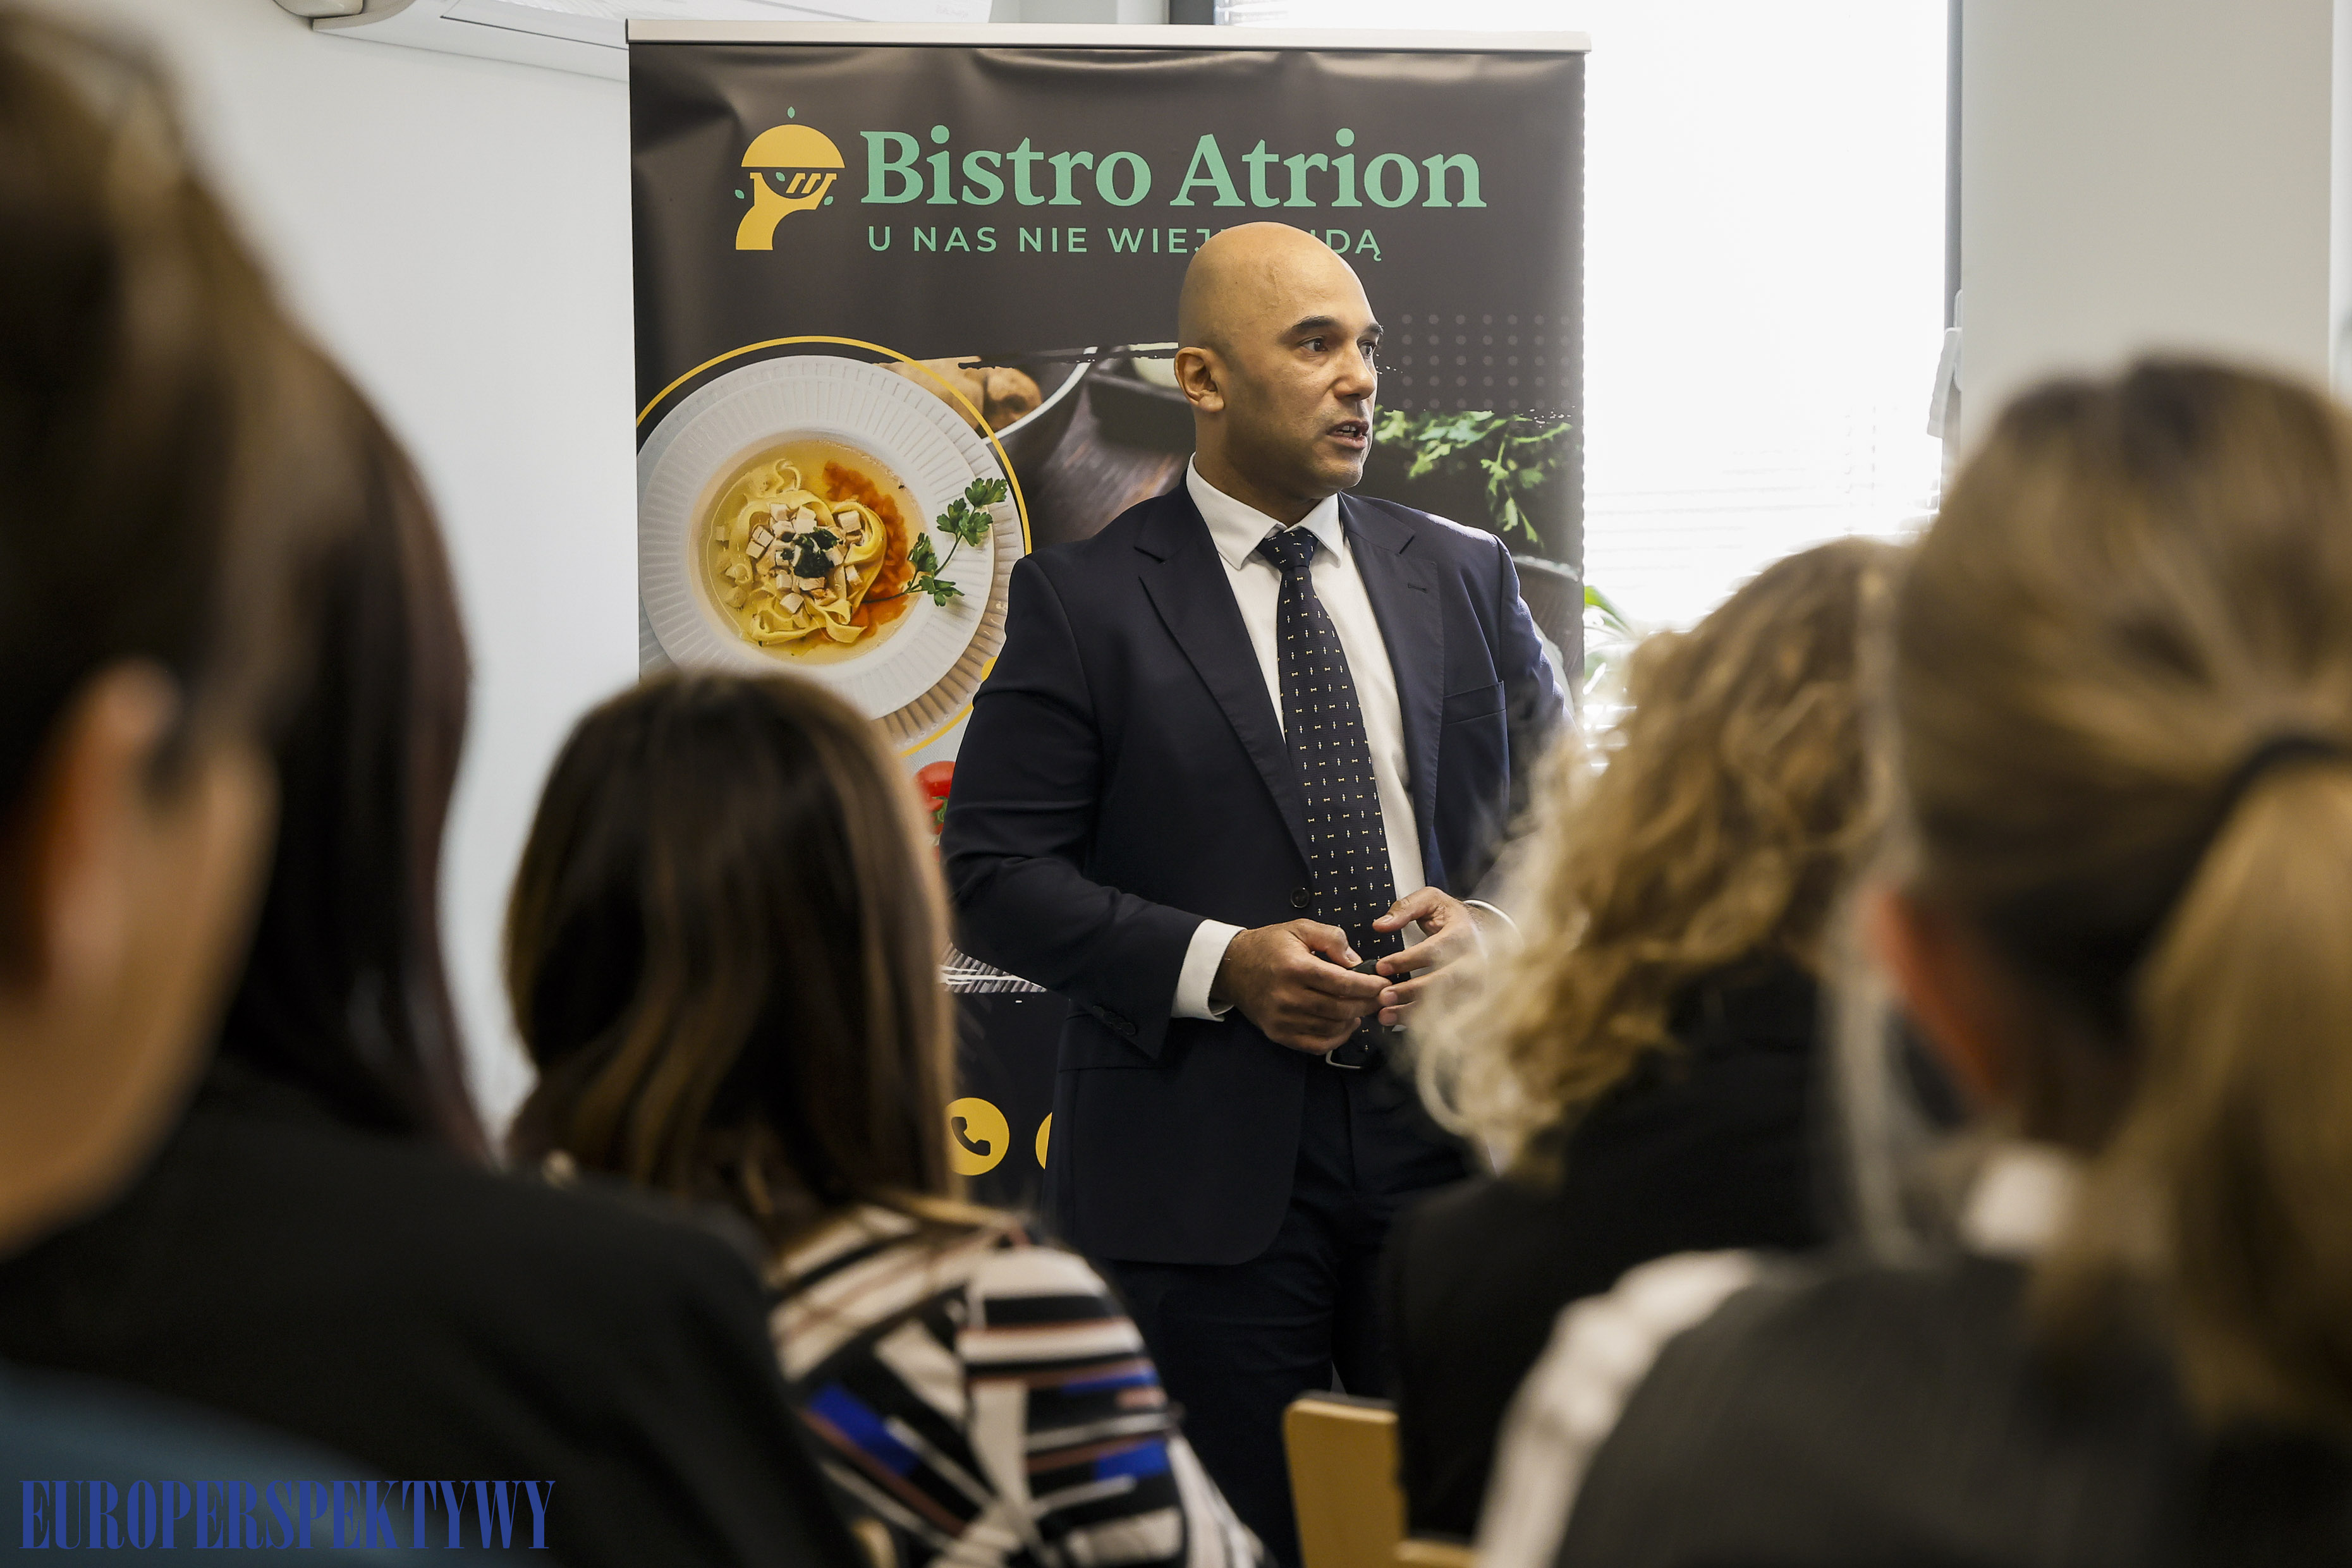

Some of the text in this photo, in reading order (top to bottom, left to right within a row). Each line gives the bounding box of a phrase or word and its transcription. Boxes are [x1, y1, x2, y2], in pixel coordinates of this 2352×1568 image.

[860, 125, 1487, 209] Bistro Atrion
[868, 226, 891, 252] U
[914, 226, 997, 252] NAS
[1019, 227, 1088, 253] NIE
[1107, 228, 1228, 253] WIEJ
